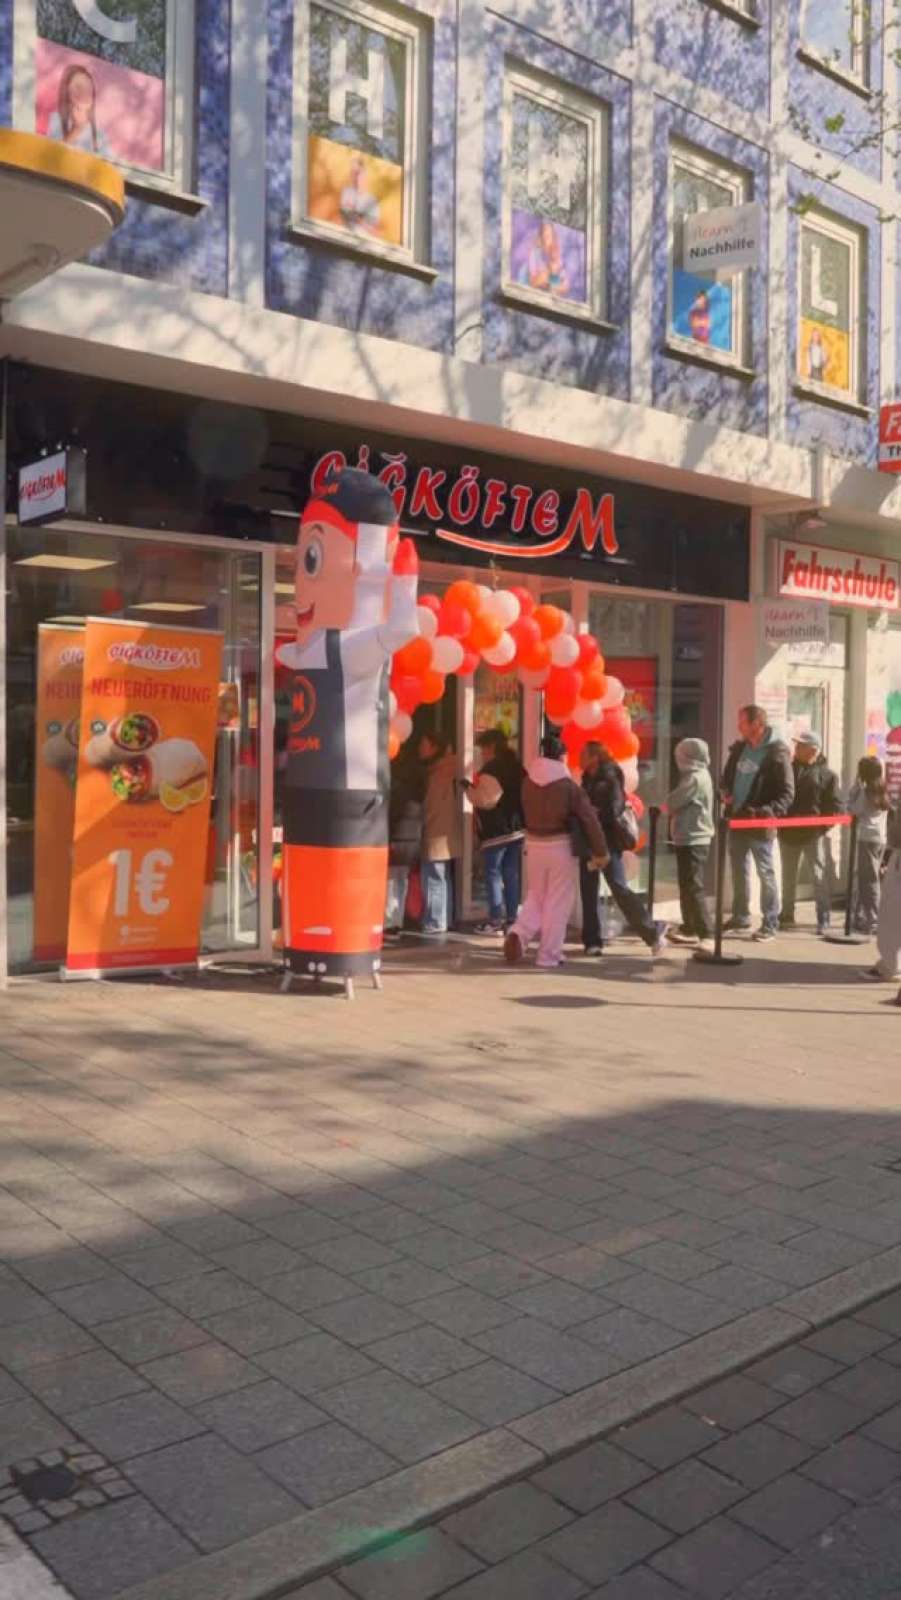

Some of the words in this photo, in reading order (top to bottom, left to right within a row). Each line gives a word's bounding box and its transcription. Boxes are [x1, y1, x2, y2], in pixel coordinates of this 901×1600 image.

[329, 36, 386, 140] H
[690, 238, 755, 260] Nachhilfe
[810, 243, 838, 317] L
[782, 549, 896, 602] Fahrschule
[764, 624, 826, 641] Nachhilfe
[90, 677, 210, 704] NEUERÖFFNUNG
[108, 848, 174, 917] 1€
